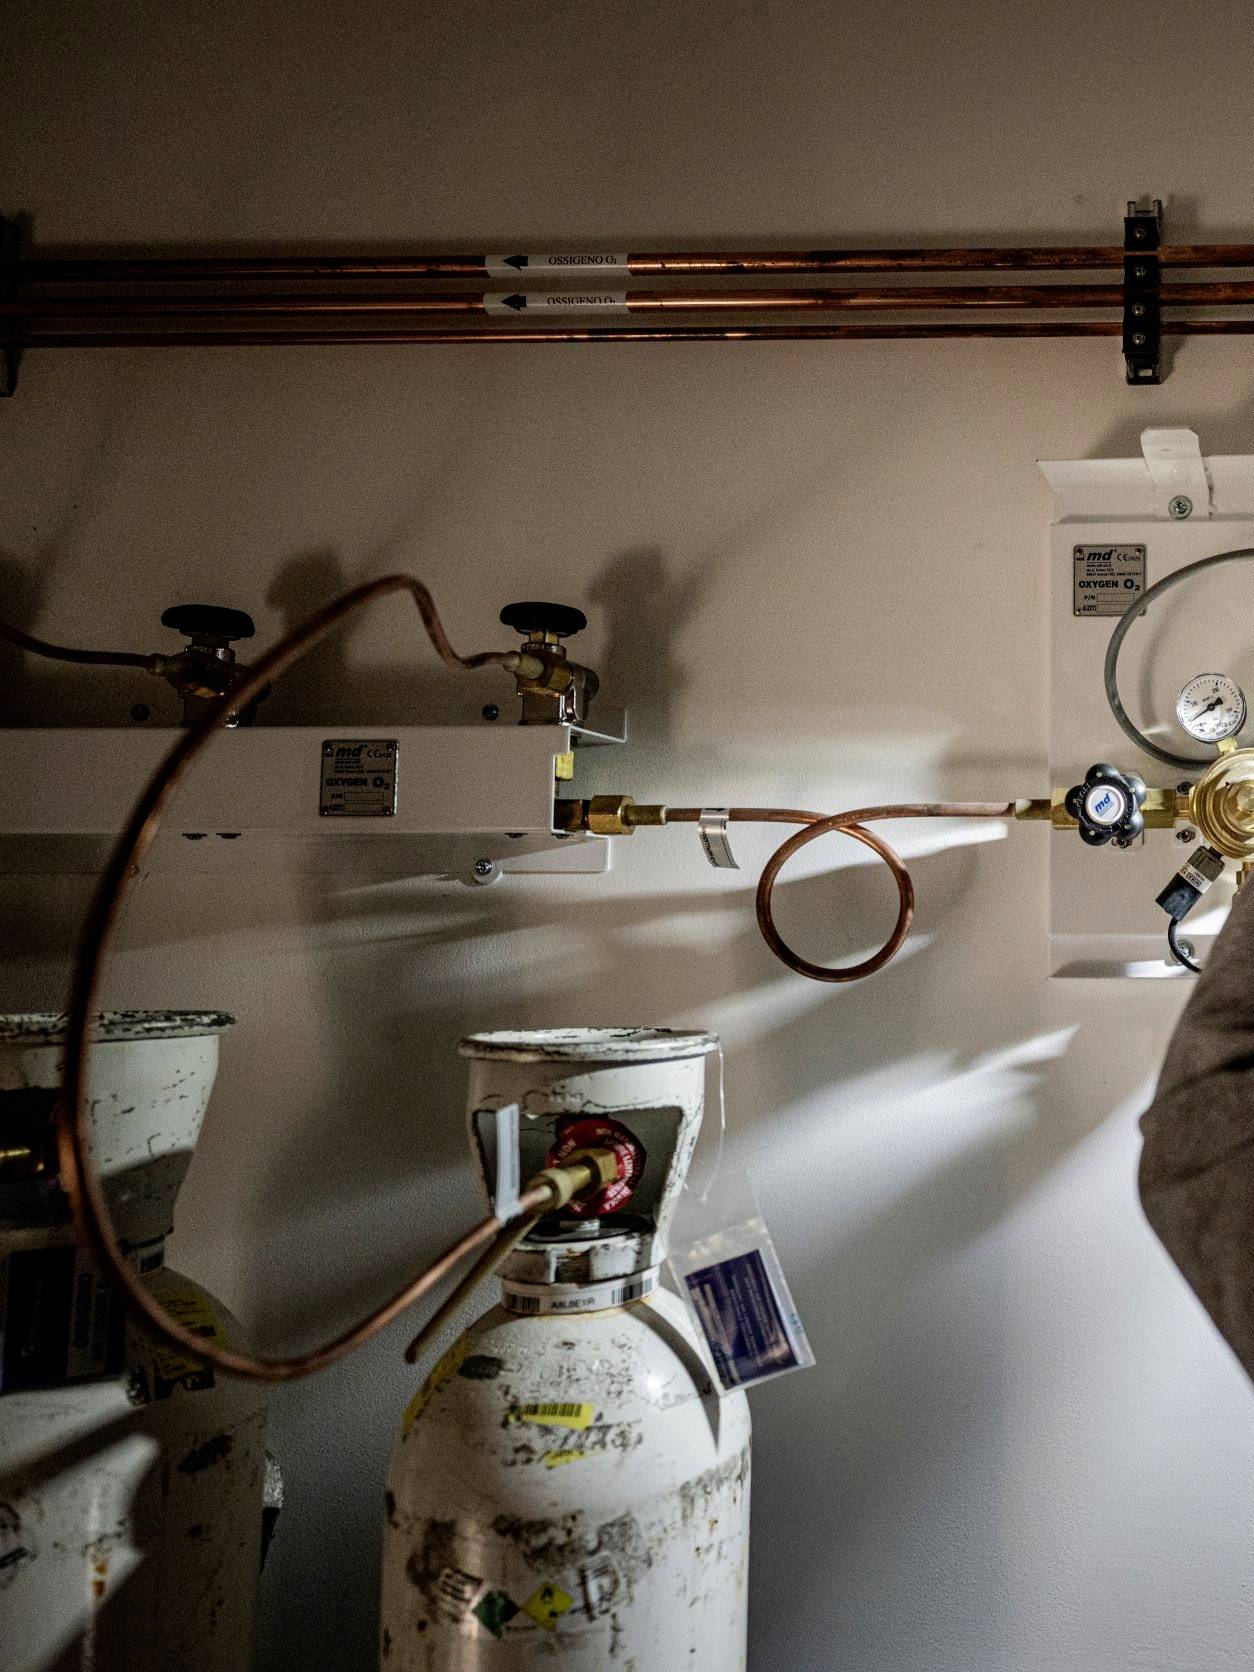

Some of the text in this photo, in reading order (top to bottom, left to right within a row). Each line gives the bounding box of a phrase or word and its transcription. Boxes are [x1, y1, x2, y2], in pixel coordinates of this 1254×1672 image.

[549, 255, 603, 265] OSSIGENO
[547, 296, 601, 306] OSSIGENO
[1079, 579, 1140, 591] OXYGEN O2
[325, 778, 368, 787] OXYGEN
[1095, 793, 1110, 813] md
